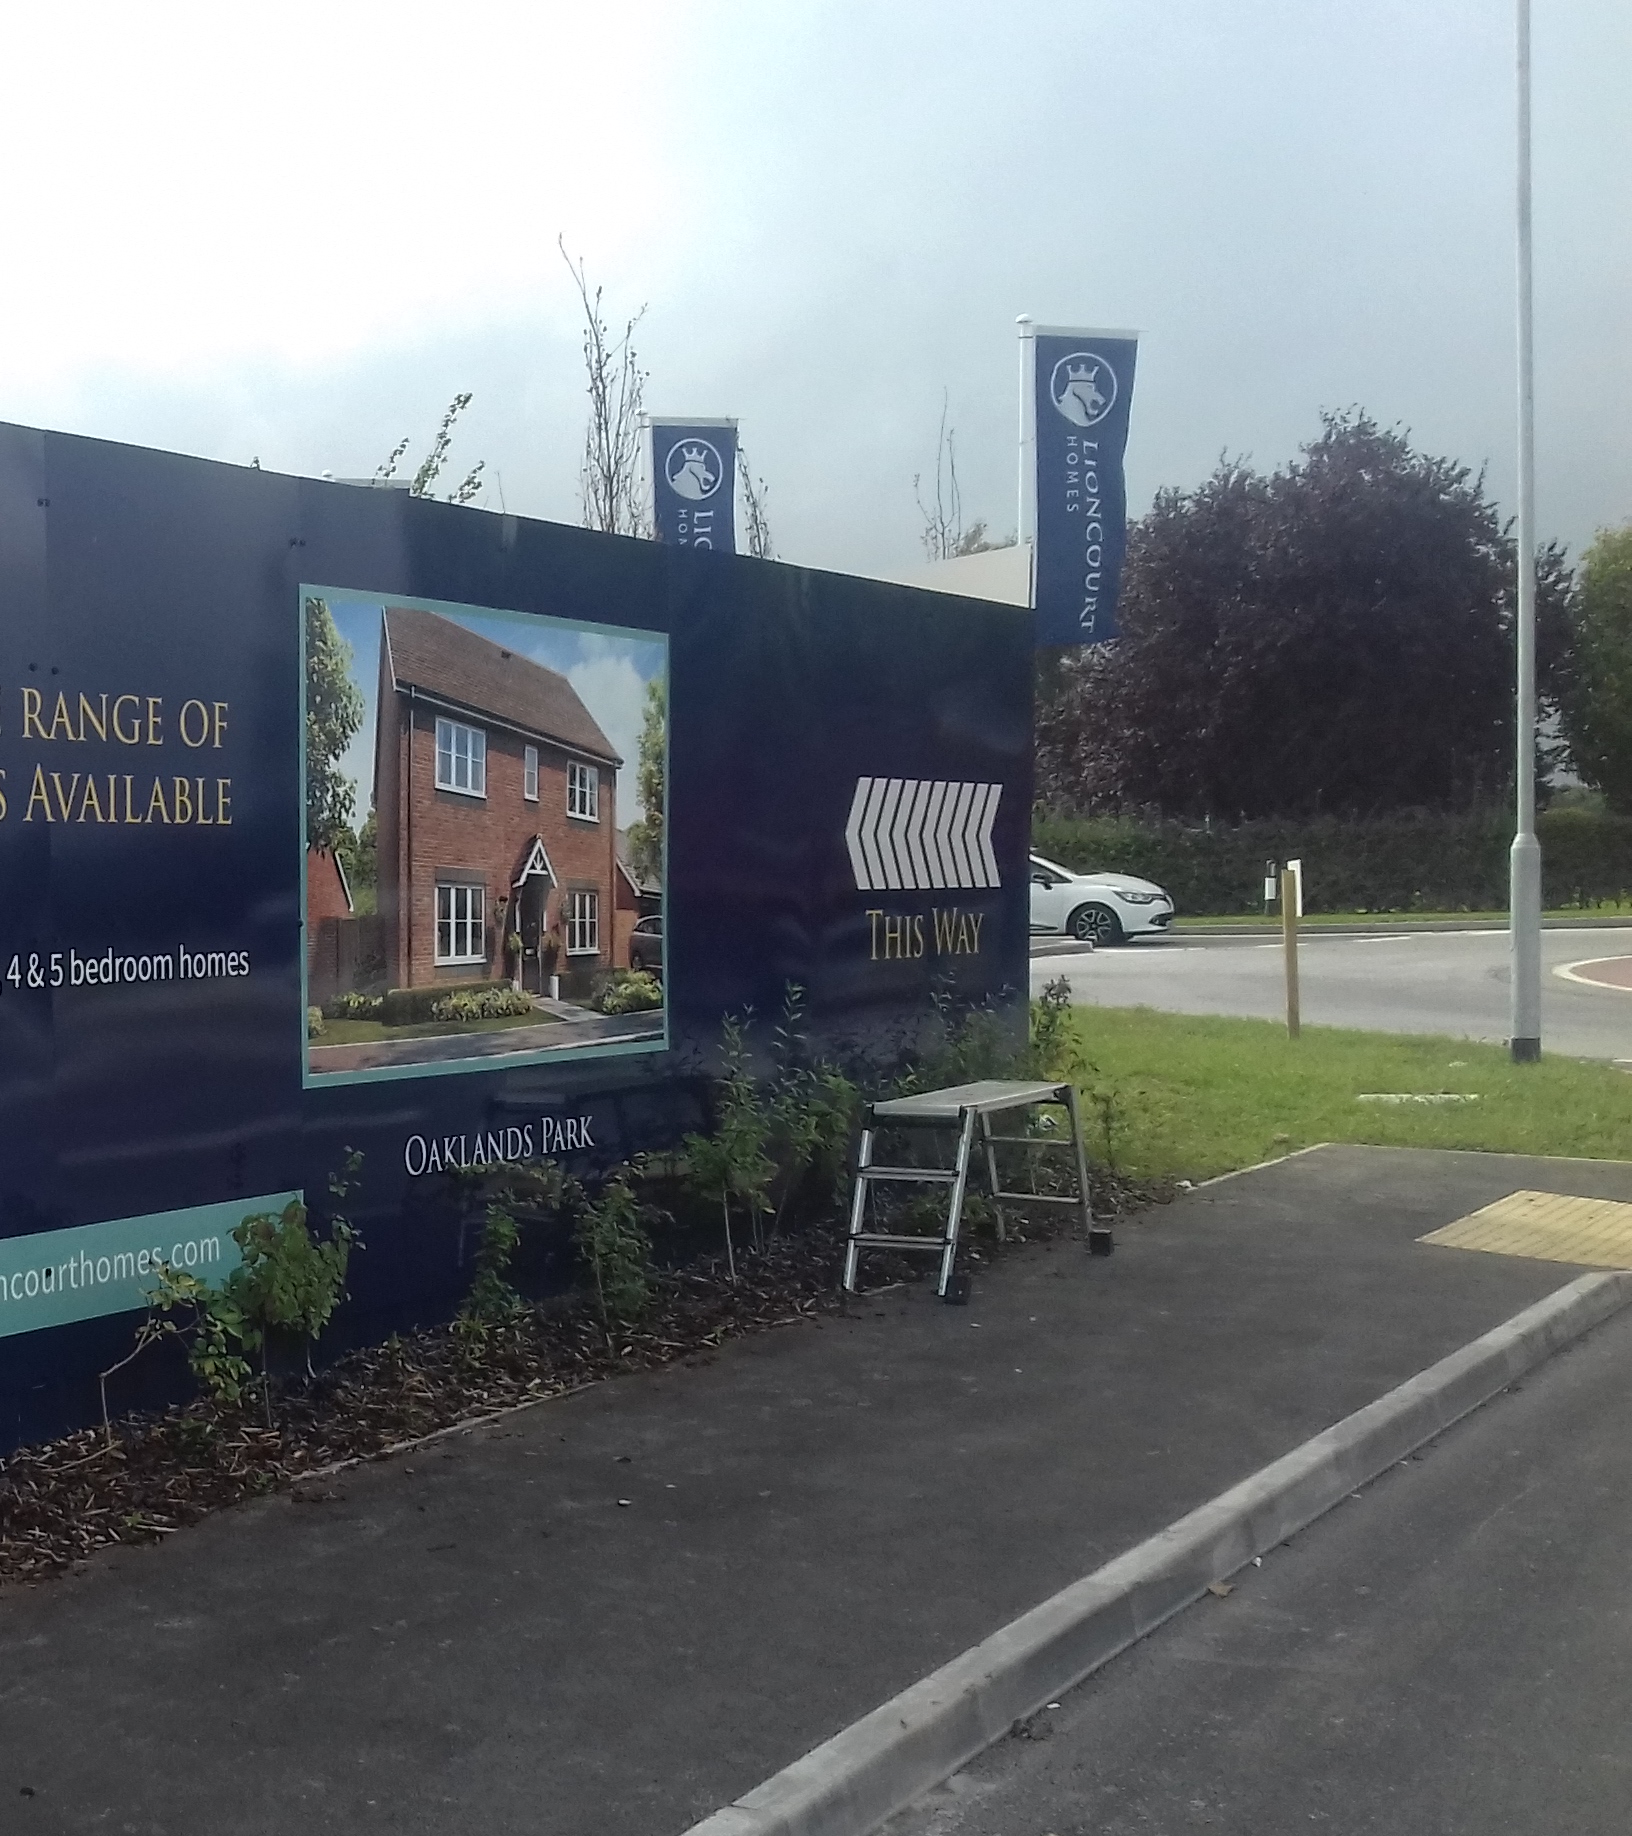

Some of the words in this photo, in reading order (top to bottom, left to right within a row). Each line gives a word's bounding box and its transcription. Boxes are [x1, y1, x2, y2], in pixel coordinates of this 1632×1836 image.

[1066, 435, 1079, 513] HOMES
[1079, 440, 1103, 634] LIONCOURT
[20, 687, 164, 745] RANGE
[179, 699, 229, 748] OF
[22, 763, 233, 825] AVAILABLE
[865, 909, 924, 960] THIS
[931, 907, 985, 956] WAY
[6, 954, 22, 989] 4
[26, 953, 45, 988] &
[49, 953, 64, 987] 5
[70, 947, 173, 986] bedroom
[179, 944, 250, 979] homes
[404, 1124, 534, 1176] OAKLANDS
[541, 1115, 595, 1154] PARK
